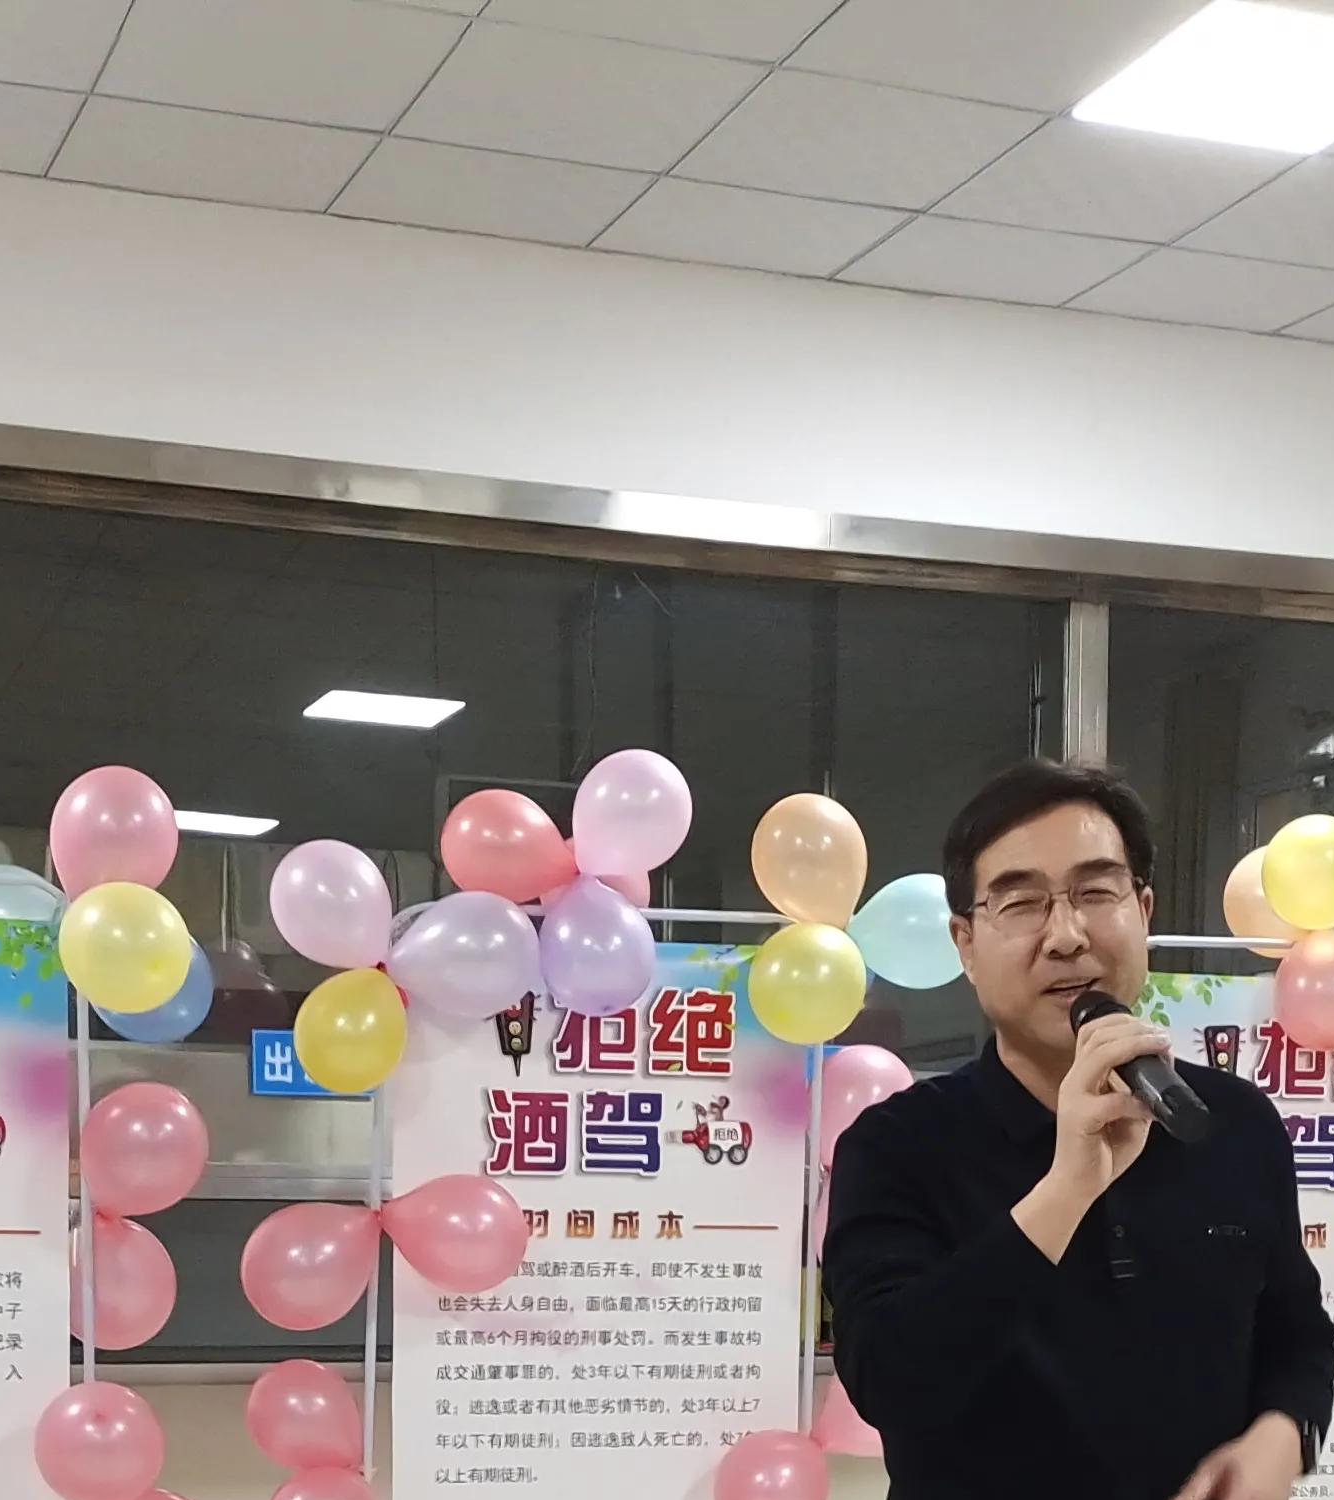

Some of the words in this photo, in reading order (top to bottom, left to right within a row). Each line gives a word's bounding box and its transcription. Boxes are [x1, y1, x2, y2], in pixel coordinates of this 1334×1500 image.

[554, 986, 737, 1077] 拒绝
[485, 1088, 664, 1177] 酒驾
[515, 1260, 763, 1279] 驾或醉酒后开车，即使不发生事故
